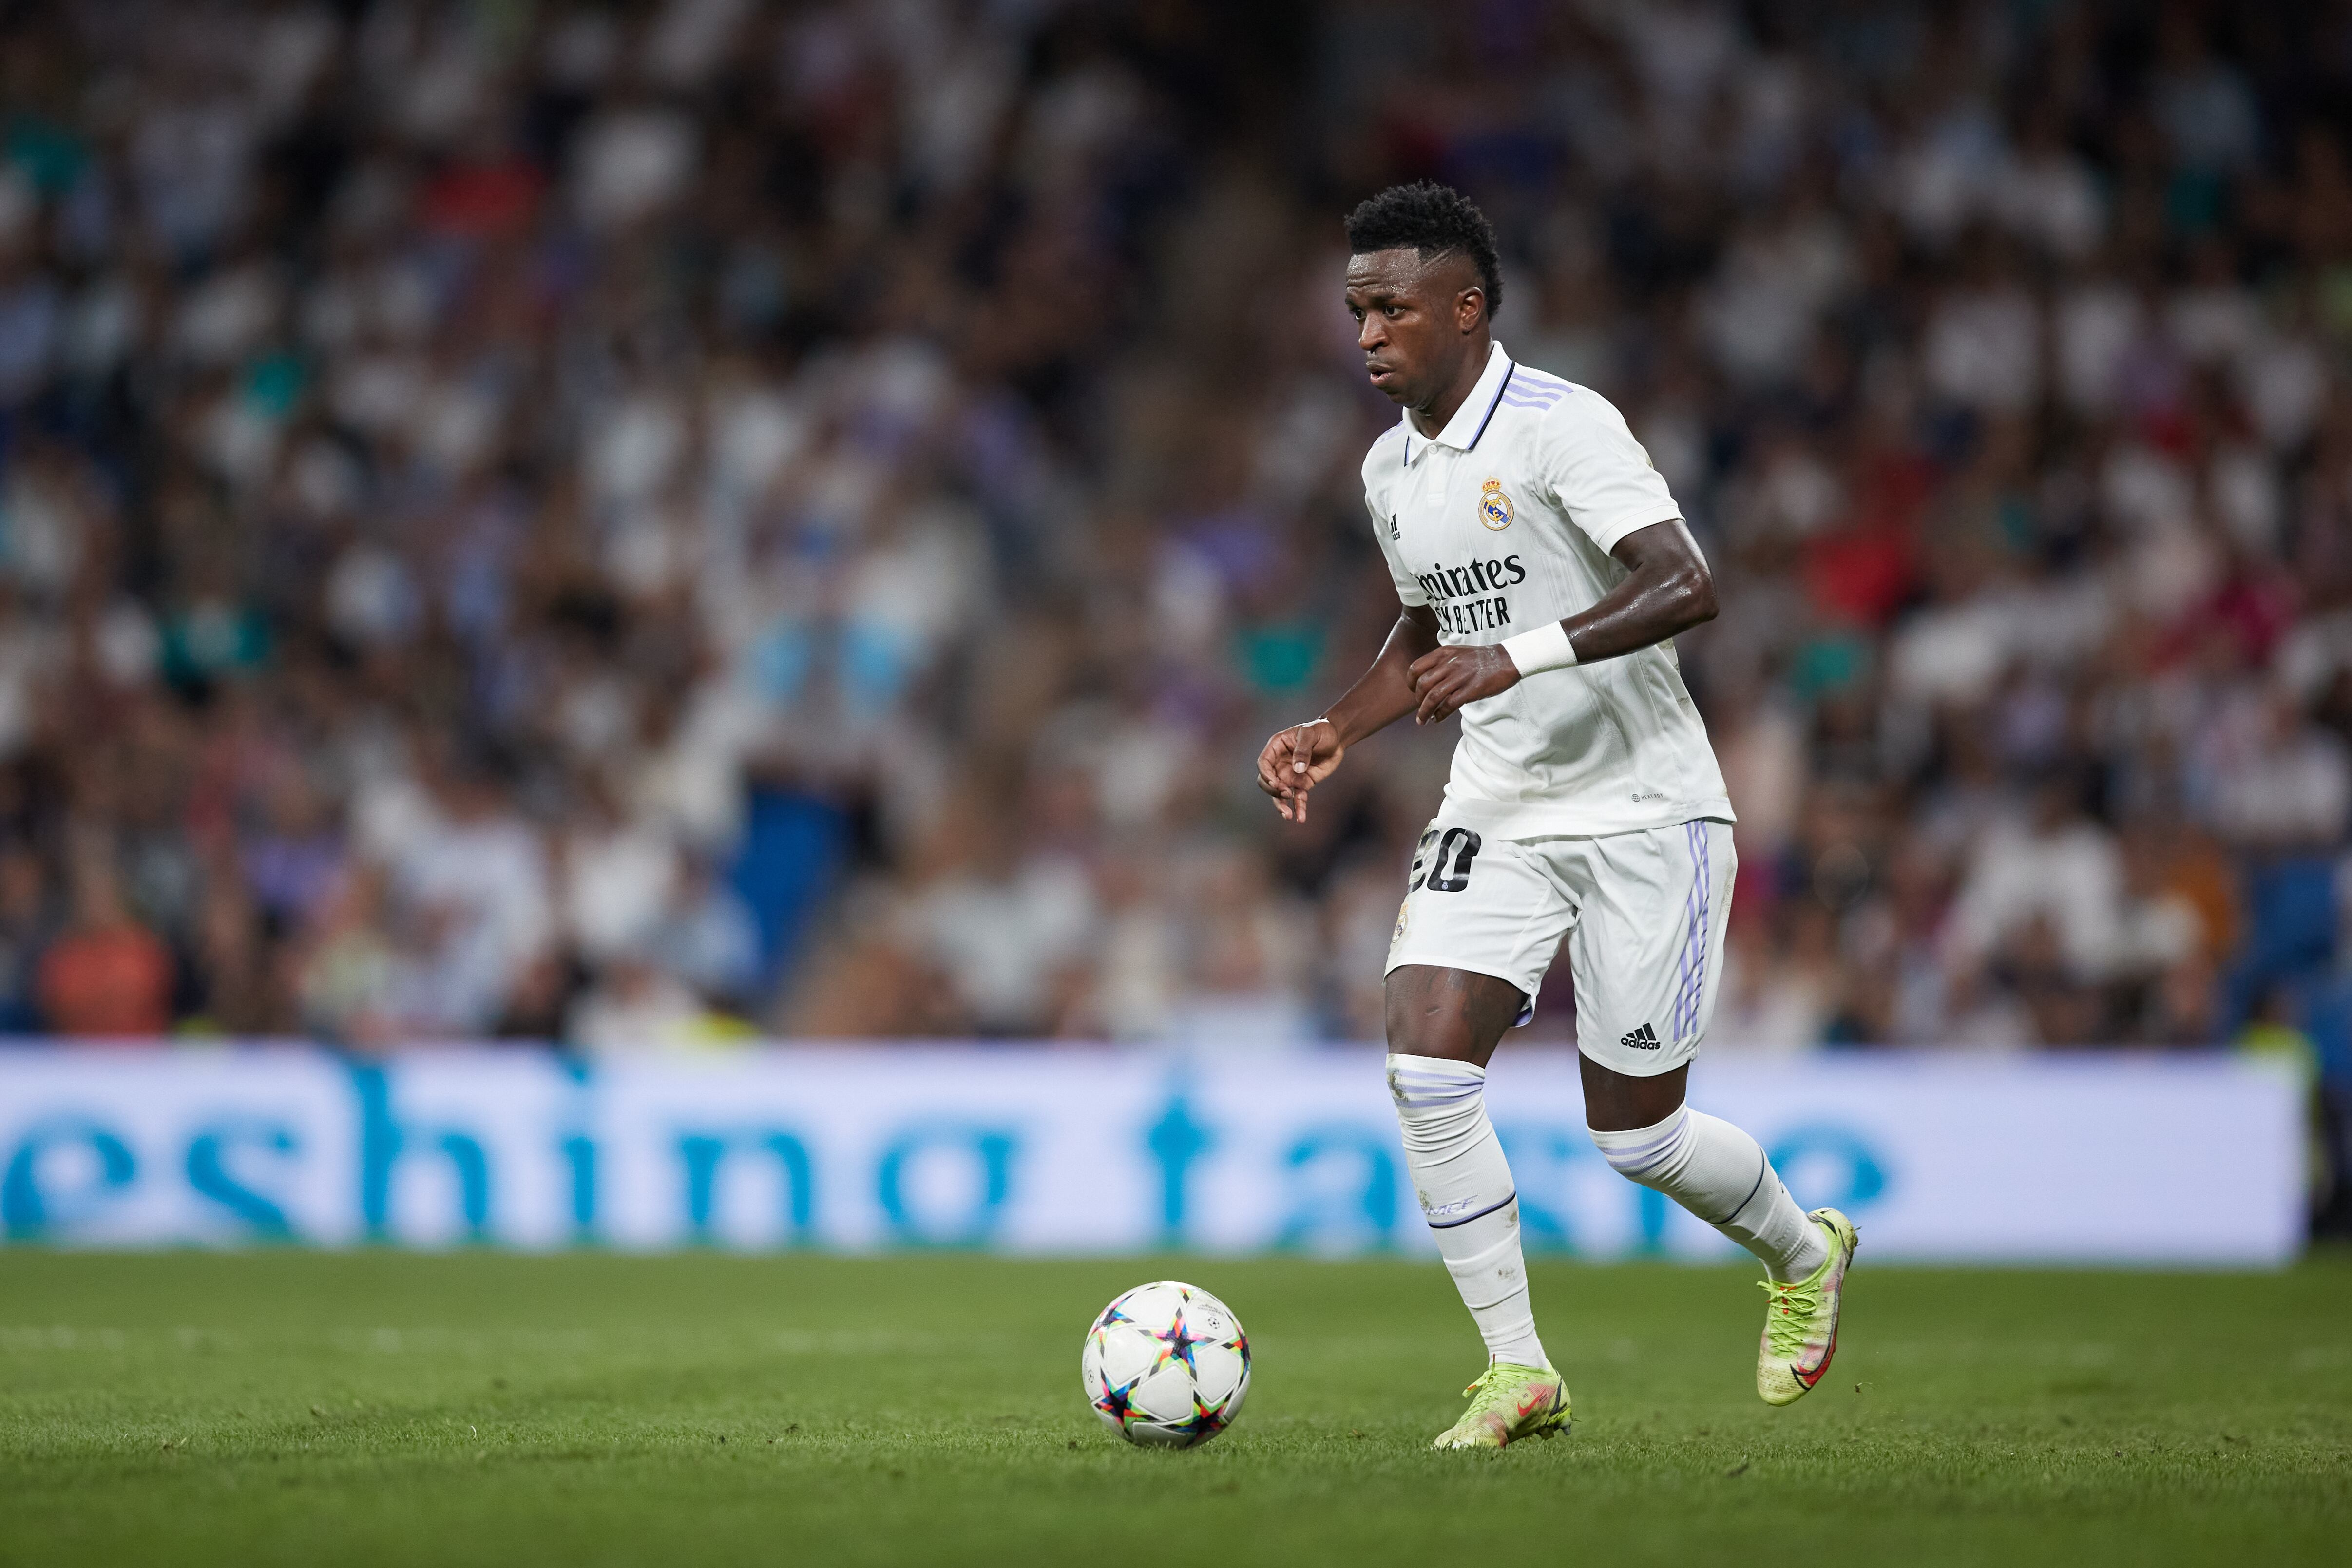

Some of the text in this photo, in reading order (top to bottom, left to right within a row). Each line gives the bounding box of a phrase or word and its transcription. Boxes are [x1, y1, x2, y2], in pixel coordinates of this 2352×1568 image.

[1410, 555, 1526, 600] mirates
[1453, 597, 1511, 634] BETTER
[1621, 1037, 1661, 1050] adidas
